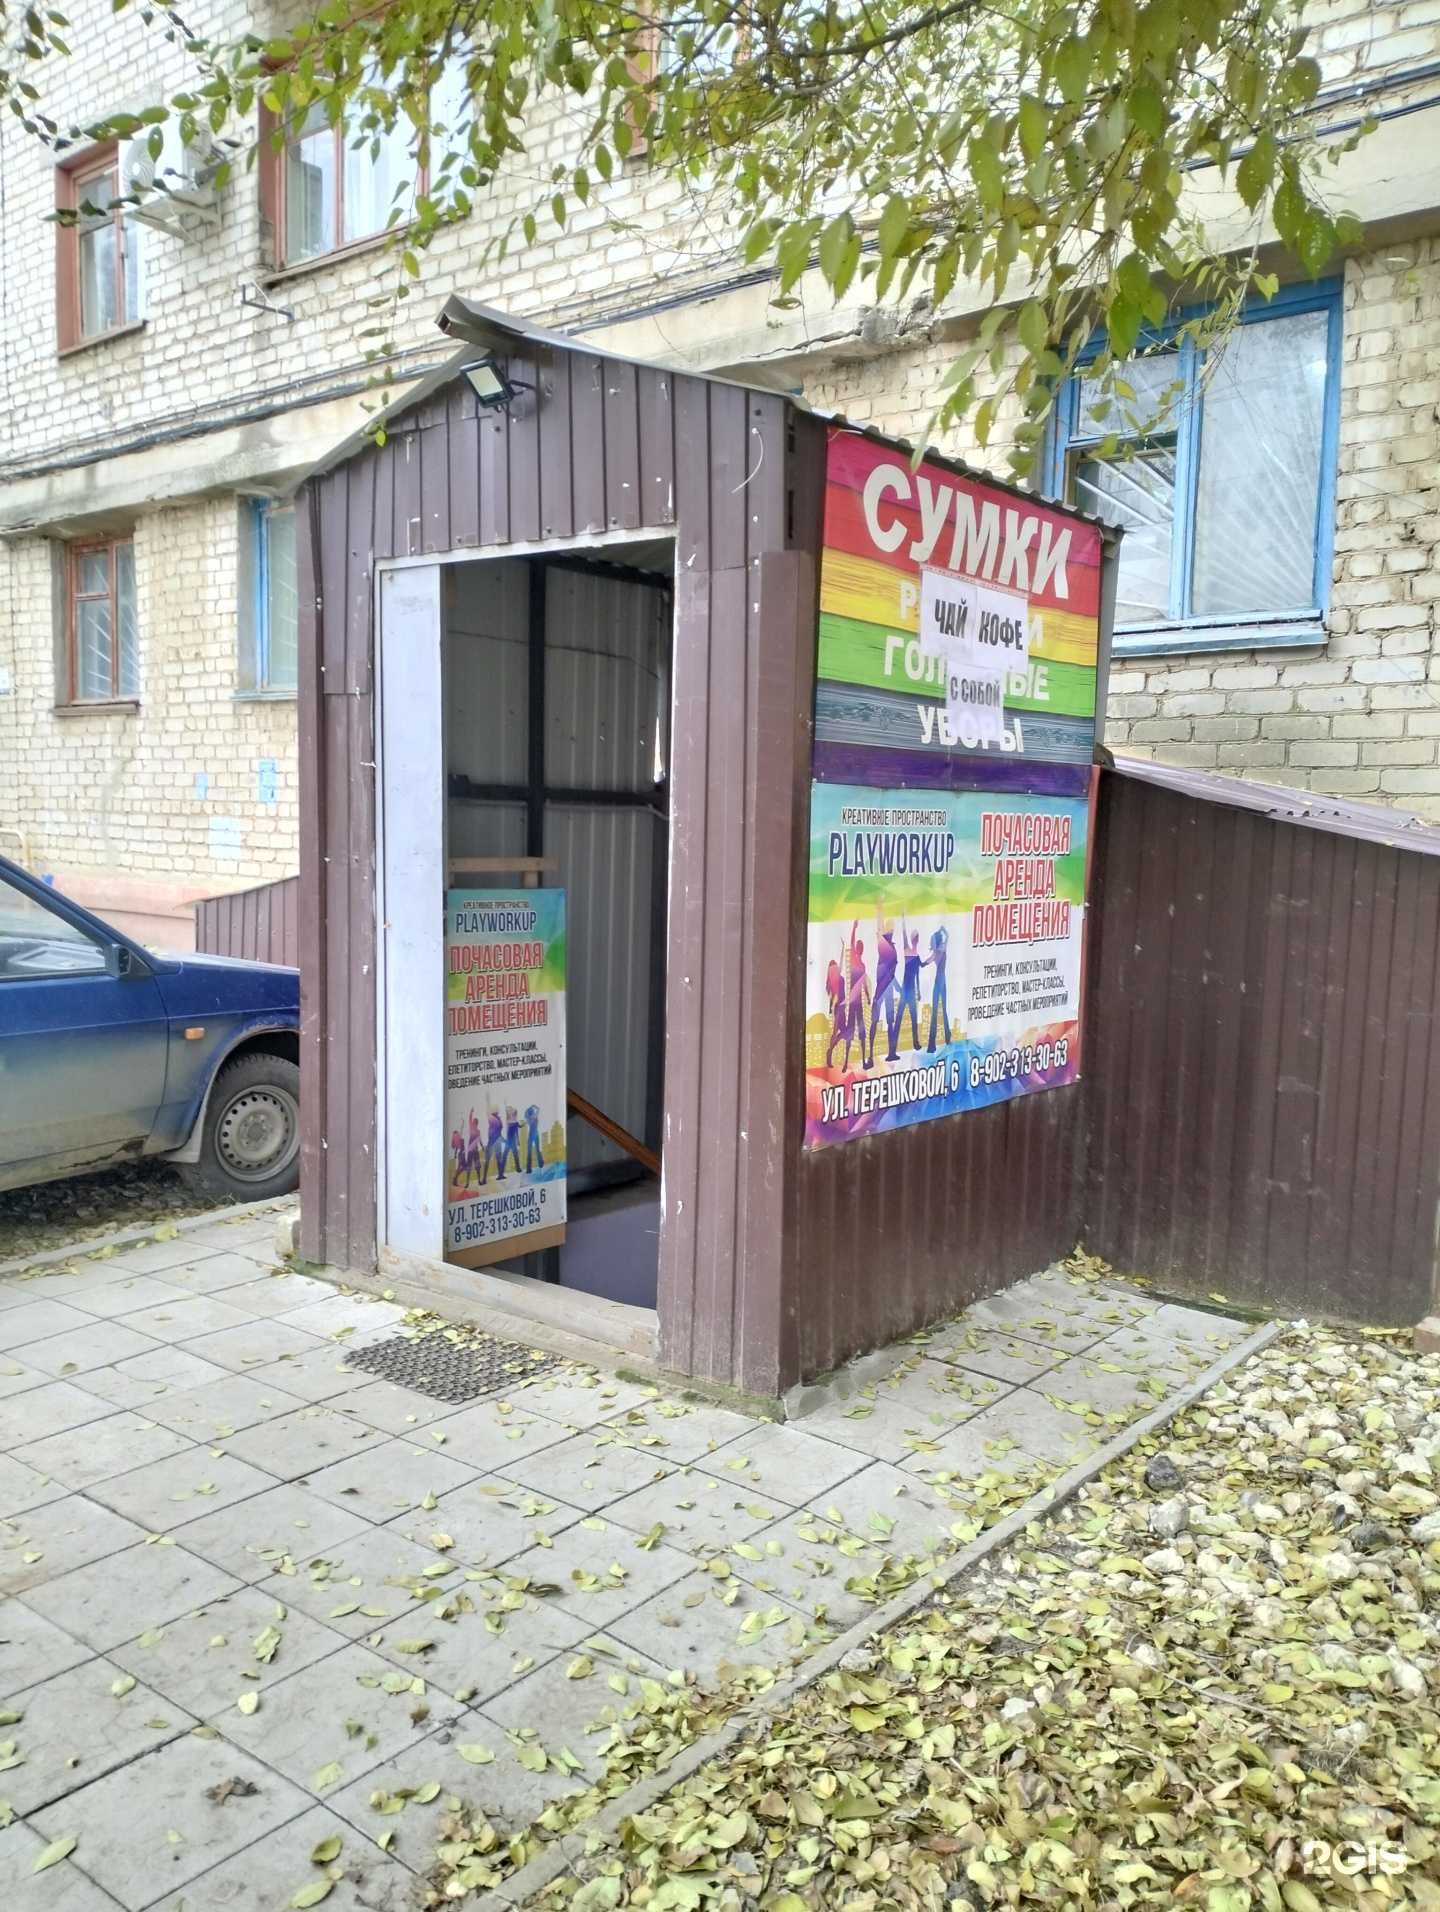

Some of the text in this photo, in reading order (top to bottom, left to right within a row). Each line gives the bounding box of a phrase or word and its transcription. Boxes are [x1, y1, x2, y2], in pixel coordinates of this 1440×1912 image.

[864, 464, 1073, 600] СУМКИ
[934, 598, 968, 639] ЧАЙ
[978, 611, 1024, 651] КОФЕ
[883, 635, 1050, 701] ГОЛЫЕ
[950, 677, 1000, 708] С СОБОЙ
[842, 808, 947, 826] КРЕАТИВНОЕ ПРОСТРАНСТВО
[981, 812, 1071, 856] ПОЧАСОВАЯ
[829, 832, 955, 876] PLAYWORKUP
[993, 858, 1056, 901] АРЕНДА
[456, 911, 537, 933] PLAYWORKUP
[972, 900, 1071, 947] ПОМЕЩЕНИЯ
[450, 943, 543, 974] ПОЧАСОВАЯ
[465, 972, 530, 1003] АРЕНДА
[968, 1002, 1004, 1021] ПРОВЕДЕНИЕ
[822, 1039, 1068, 1123] УЛ. ТЕРЕШКОВОЙ, 6 8-902-313-30-63
[448, 1206, 467, 1225] УЛ.
[540, 1188, 546, 1204] 6
[455, 1207, 541, 1243] 8-902-313-30-63
